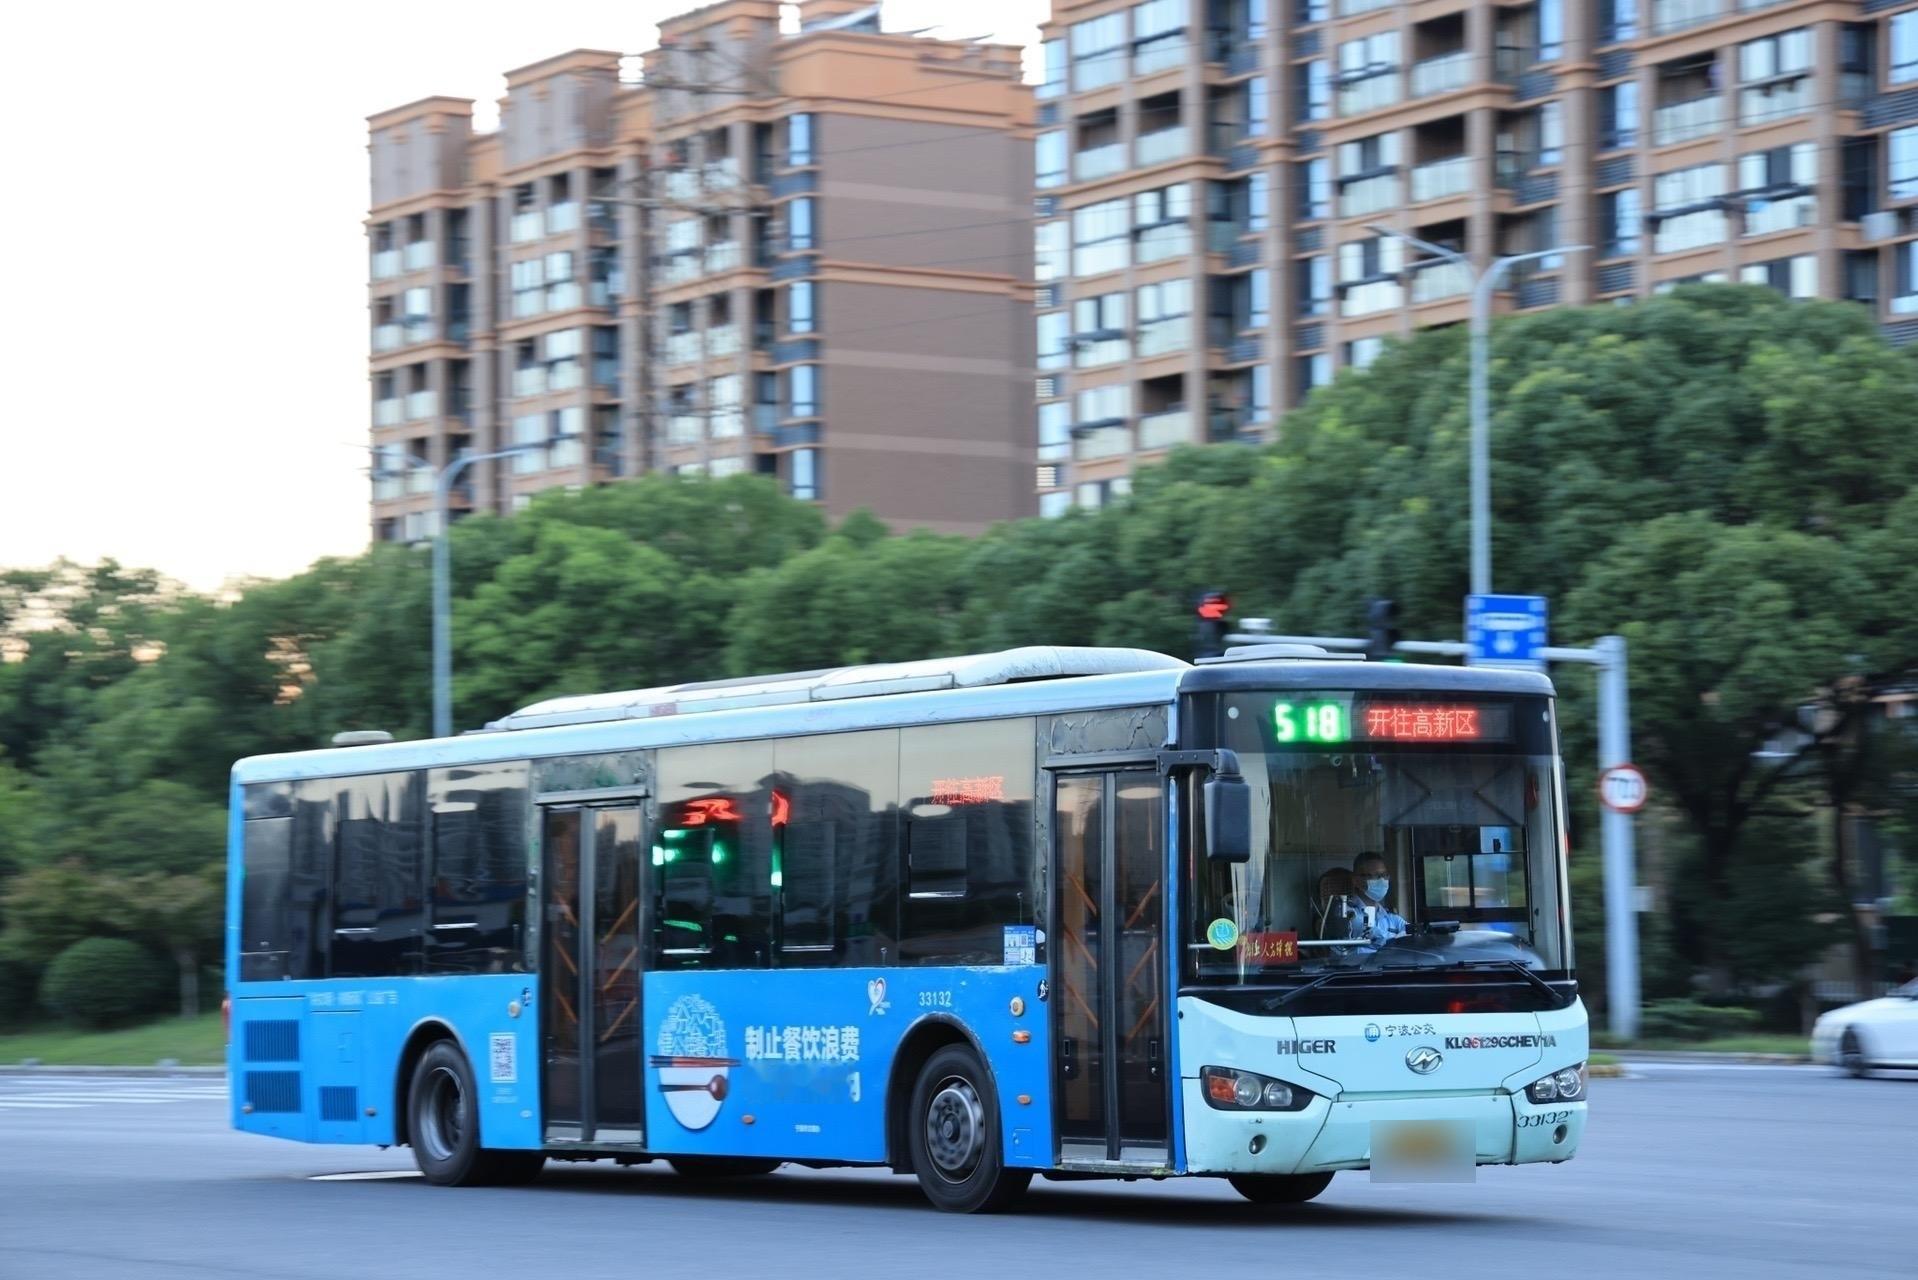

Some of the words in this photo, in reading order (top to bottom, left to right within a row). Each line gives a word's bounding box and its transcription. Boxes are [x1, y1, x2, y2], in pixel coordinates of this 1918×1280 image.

[1275, 703, 1340, 743] 518
[1368, 707, 1476, 738] 开往高新区
[919, 991, 952, 1007] 33132
[1384, 1023, 1436, 1037] 宁波公交
[745, 1025, 860, 1061] 制止餐饮浪费
[1277, 1039, 1336, 1055] HIGER
[1517, 1110, 1570, 1128] 33132
